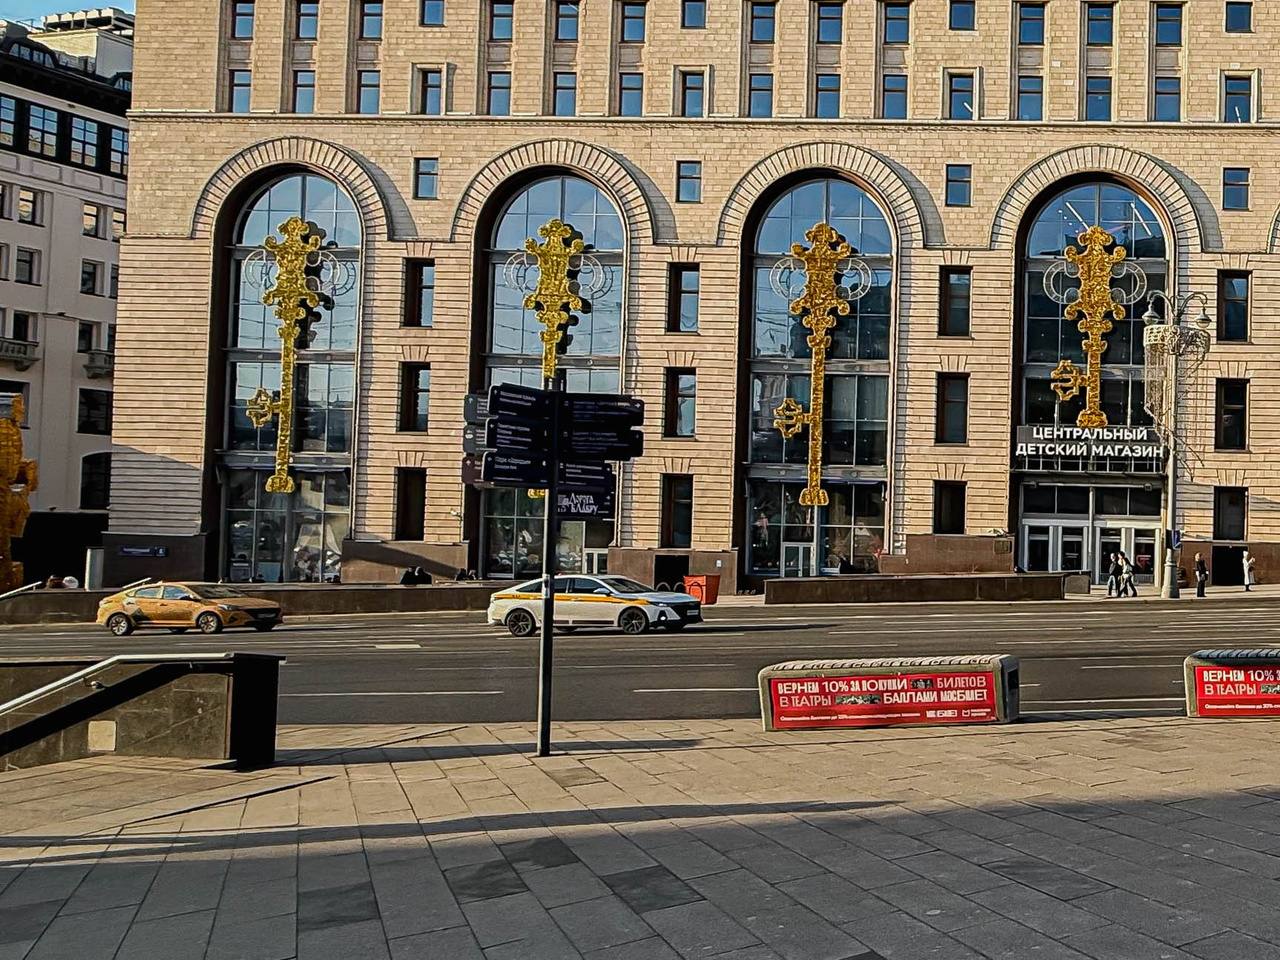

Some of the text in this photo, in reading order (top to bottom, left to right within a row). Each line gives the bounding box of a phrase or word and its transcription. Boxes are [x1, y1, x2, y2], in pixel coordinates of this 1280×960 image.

[1033, 426, 1147, 441] ЦЕНТРАЛЬНЫЙ
[1016, 442, 1164, 458] ДЕТСКИЙ МАГАЗИН
[1203, 670, 1245, 682] ВЕРНЕМ
[1248, 669, 1274, 681] 10%
[778, 676, 986, 694] ВЕРНЕМ 10% ЗА ПОКУПКИ БИЛЕТОВ
[1205, 684, 1214, 695] В
[1216, 684, 1256, 695] ТЕАТРЫ
[779, 697, 789, 707] В
[792, 695, 831, 706] ТЕАТРЫ
[883, 692, 938, 704] БАЛЛАМИ
